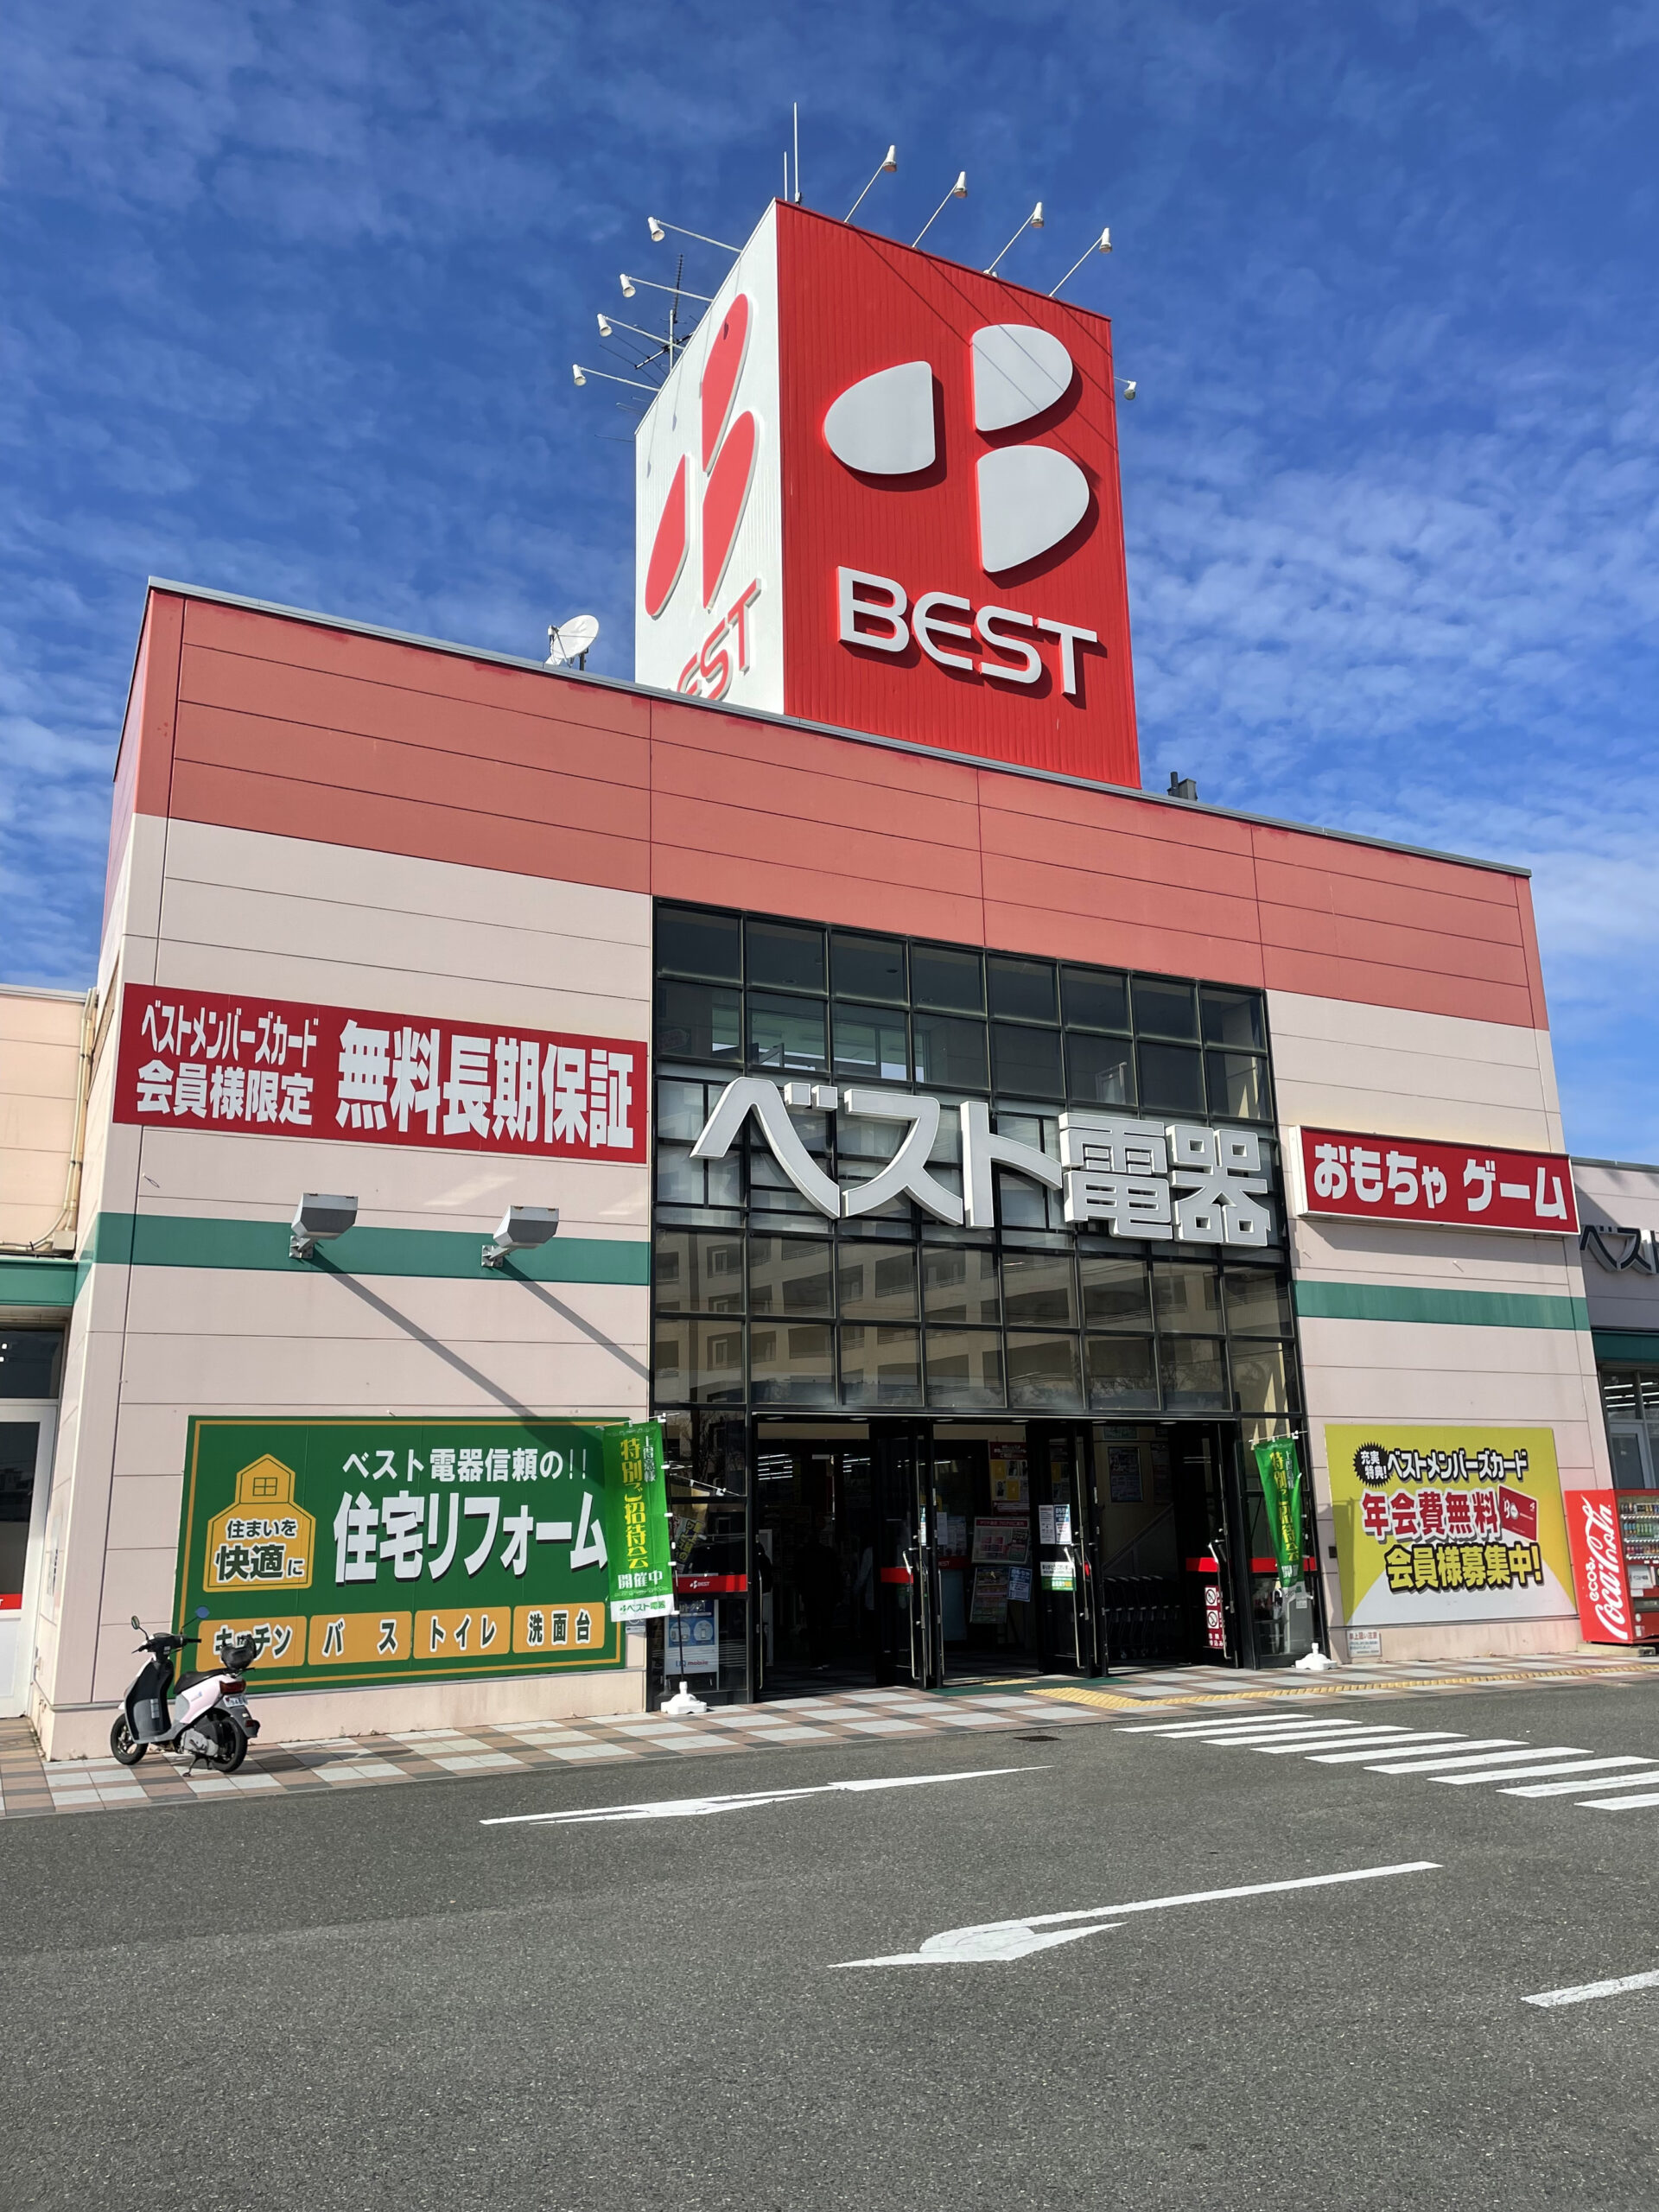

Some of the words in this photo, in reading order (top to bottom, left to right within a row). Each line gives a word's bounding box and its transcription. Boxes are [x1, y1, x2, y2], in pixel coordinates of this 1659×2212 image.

[837, 566, 1097, 696] BEST
[141, 999, 319, 1069] ベストメンバーズカード
[136, 1059, 314, 1126] 会員様限定
[335, 1020, 633, 1149] 無料長期保証
[690, 1077, 1271, 1247] ベスト電器
[1313, 1143, 1447, 1209] おもちゃ
[1463, 1159, 1568, 1220] ゲーム
[1361, 1451, 1380, 1464] 充実
[1389, 1448, 1529, 1481] ベストメンバーズカード
[226, 1518, 297, 1539] 住まいを
[334, 1491, 608, 1584] 住宅リフォーム
[1361, 1490, 1500, 1539] 年会費無料
[215, 1545, 305, 1580] 快適に
[618, 1570, 663, 1589] 開催中
[1386, 1544, 1542, 1591] 会員様募集中!
[429, 1614, 497, 1652] トイレ
[528, 1612, 592, 1646] 洗面台
